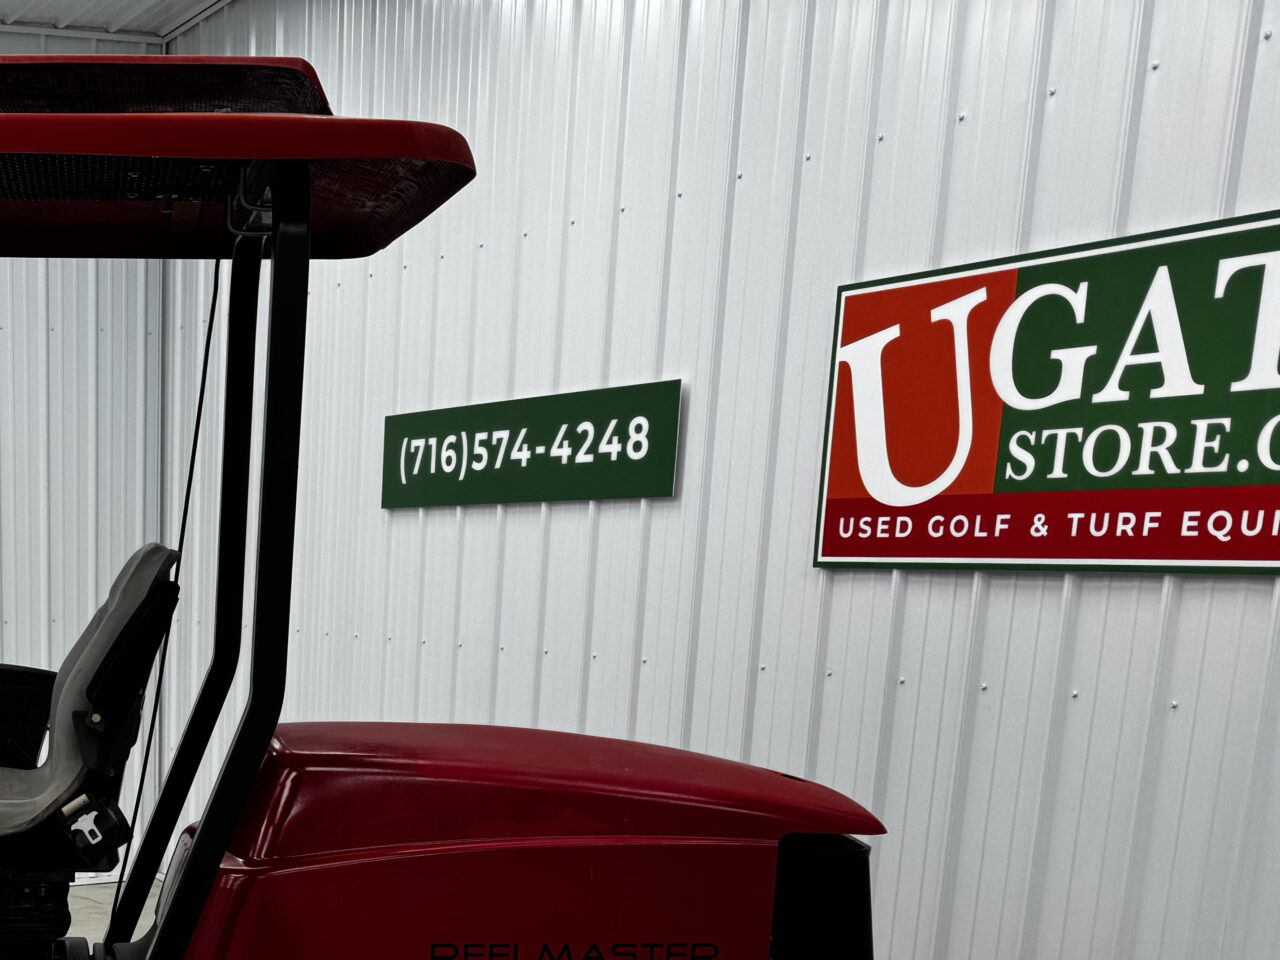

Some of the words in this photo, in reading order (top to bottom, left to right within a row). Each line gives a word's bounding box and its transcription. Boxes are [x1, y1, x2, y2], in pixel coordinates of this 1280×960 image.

[400, 415, 650, 485] (716)574-4248
[839, 515, 913, 539] USED
[927, 513, 1012, 538] GOLF
[1029, 512, 1049, 538] &
[1067, 511, 1162, 537] TURF
